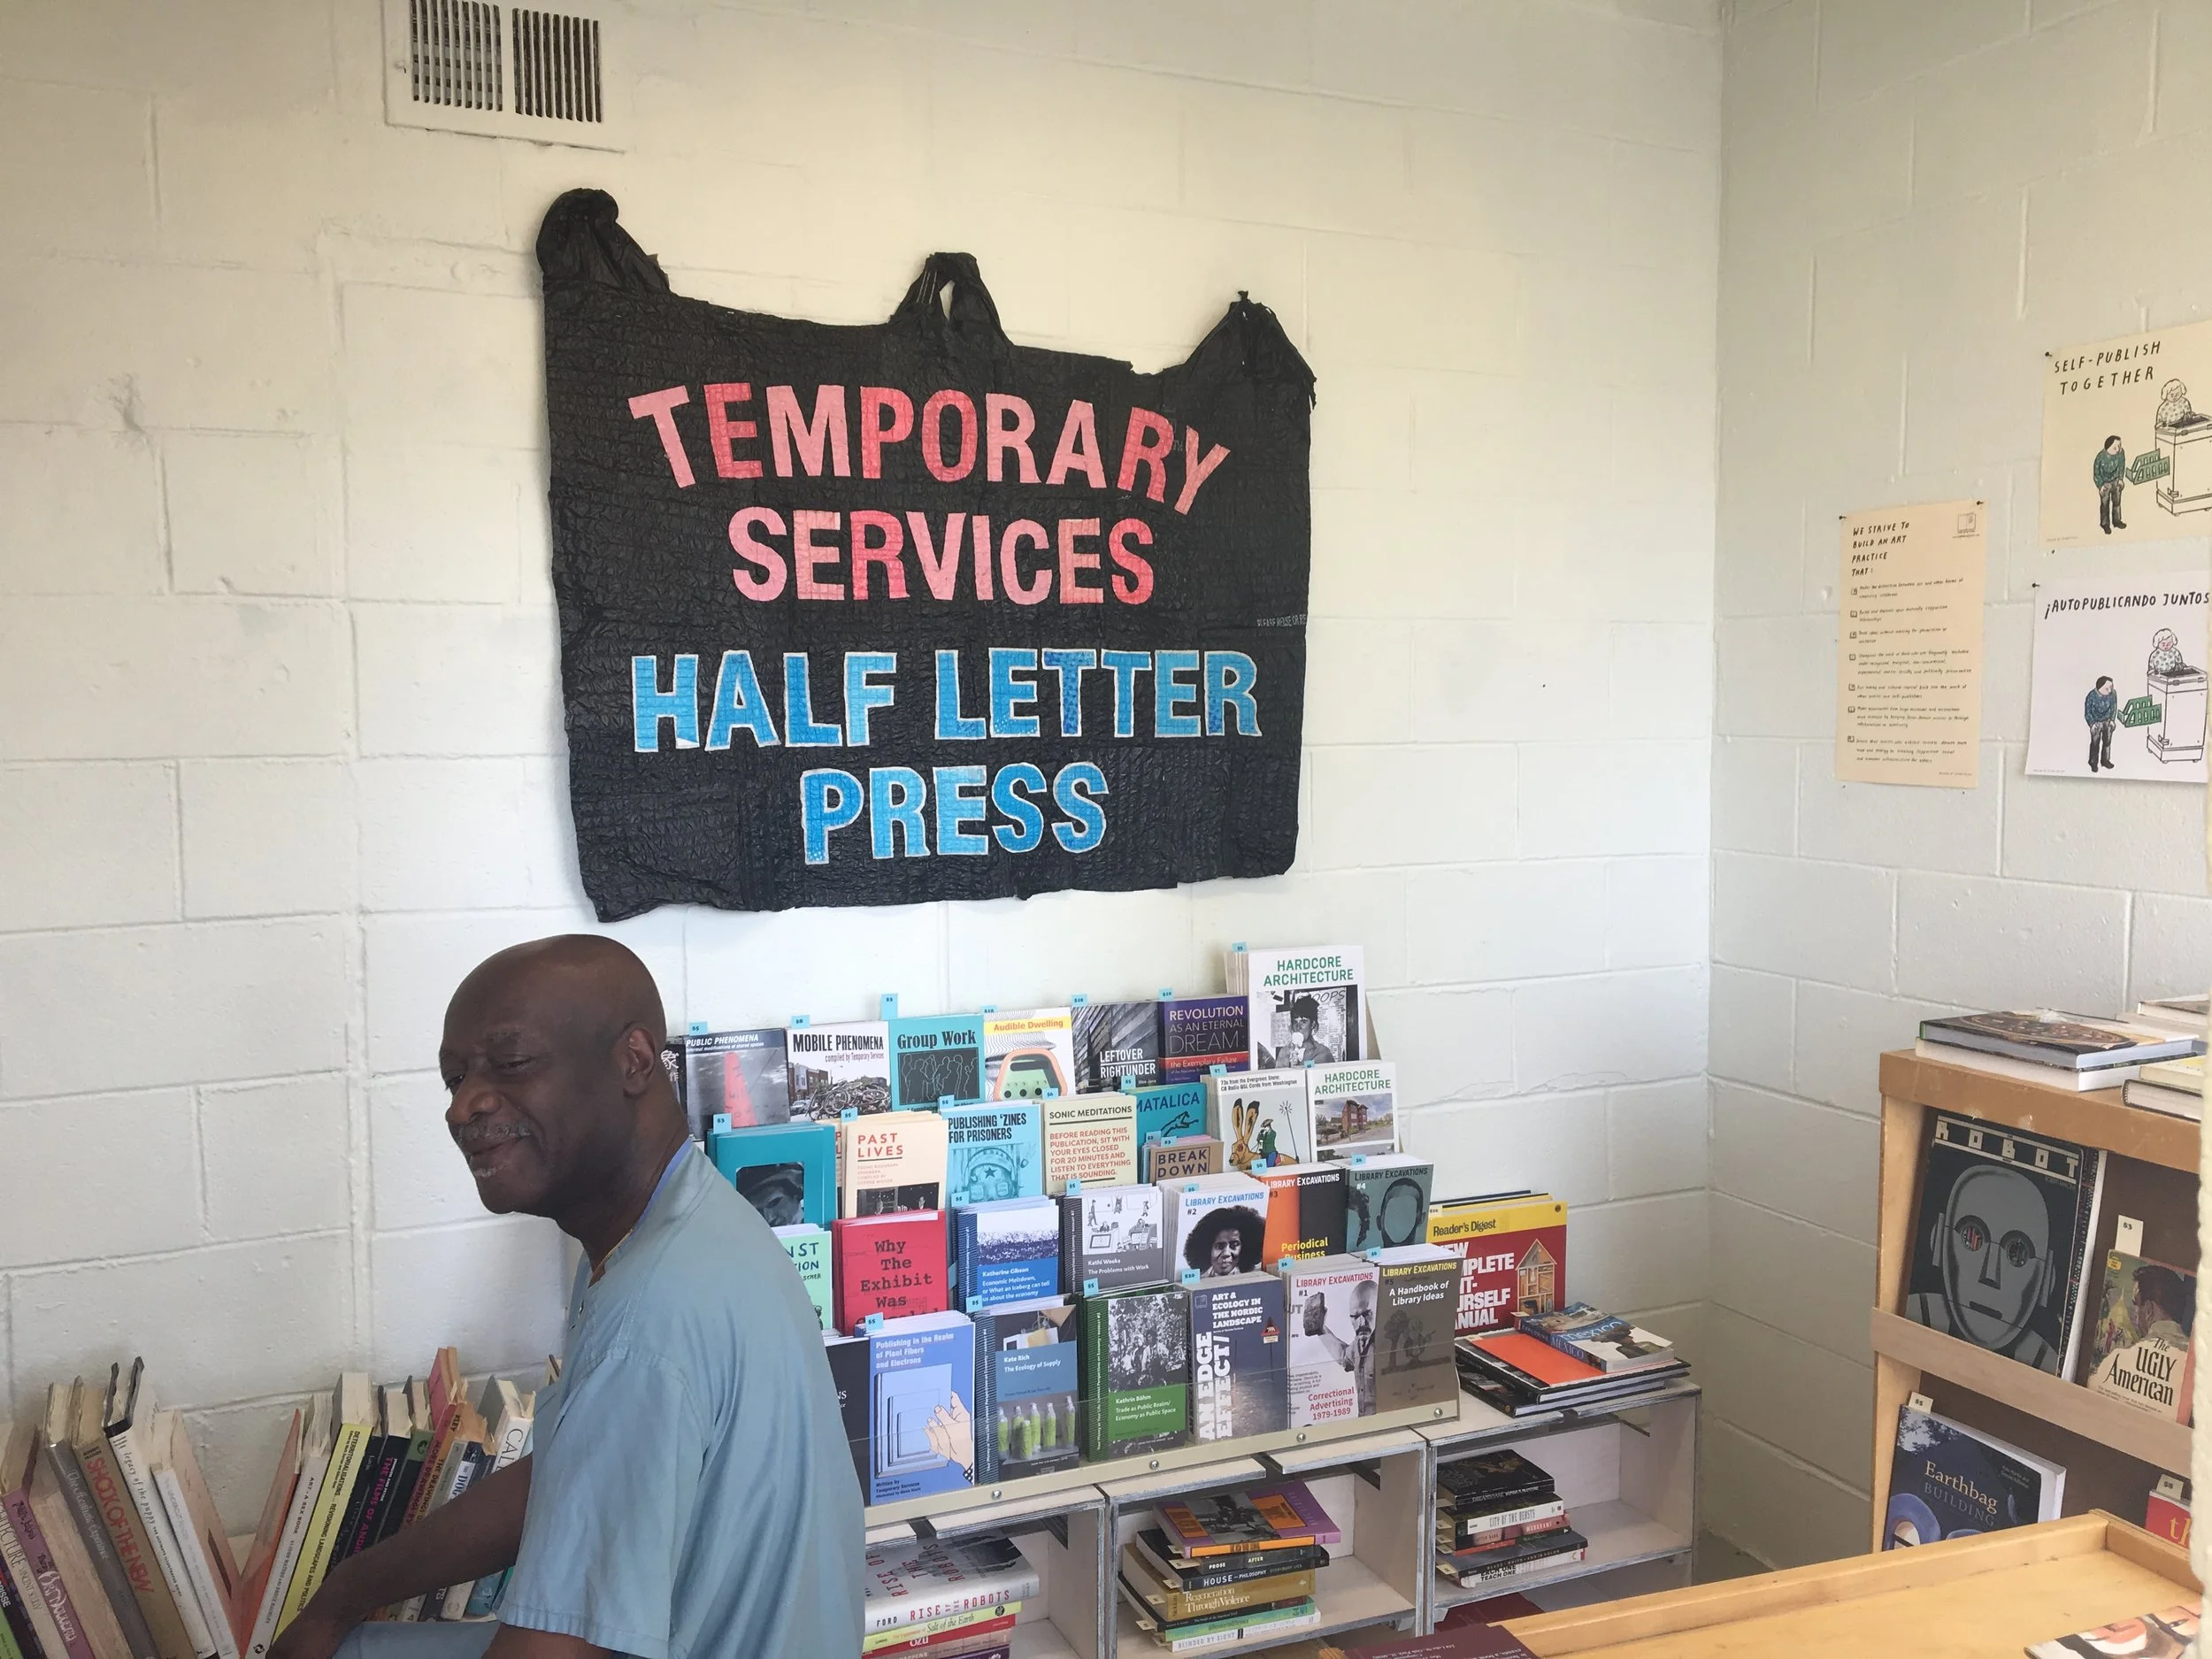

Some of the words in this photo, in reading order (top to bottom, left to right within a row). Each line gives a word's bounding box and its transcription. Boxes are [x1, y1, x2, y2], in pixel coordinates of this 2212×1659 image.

[2055, 341, 2161, 373] SELF-PUBLISH
[2060, 365, 2154, 395] TOGETHER
[628, 383, 1231, 516] TEMPORARY
[1853, 526, 1863, 536] WE
[1868, 523, 1897, 534] STRIVE
[1853, 539, 1875, 549] BUILD
[1891, 535, 1907, 544] ART
[728, 507, 1155, 604] SERVICES
[1852, 552, 1888, 564] PRACTICE
[2162, 592, 2211, 606] JUNTOS
[630, 650, 897, 752] HALF
[934, 648, 1262, 741] LETTER
[801, 762, 1110, 865] PRESS
[1277, 956, 1341, 972] HARDCORE
[1263, 969, 1354, 987] ARCHITECTURE
[1170, 1005, 1243, 1021] REVOLUTION
[994, 1022, 1025, 1032] Audible
[1027, 1019, 1064, 1030] Dwelling
[1170, 1024, 1183, 1033] AS
[1186, 1023, 1200, 1032] AN
[1202, 1020, 1244, 1030] ETERNAL
[686, 1038, 712, 1047] PUBLIC
[714, 1033, 759, 1045] PHENOMENA
[793, 1033, 833, 1052] MOBILE
[835, 1033, 884, 1051] PHENOMENA
[897, 1033, 938, 1049] Group
[941, 1029, 977, 1046] Work
[1100, 1048, 1143, 1062] LEFTOVER
[1100, 1063, 1156, 1079] RIGHTUNDER
[1325, 1070, 1380, 1084] HARDCORE
[1314, 1079, 1391, 1095] ARCHITECTURE
[1049, 1110, 1076, 1119] SONIC
[1077, 1106, 1132, 1117] MEDITATIONS
[949, 1117, 997, 1130] PUBLISHING
[857, 1133, 898, 1145] PAST
[949, 1130, 965, 1143] FOR
[967, 1127, 1012, 1142] PRISONERS
[1049, 1131, 1079, 1140] BEFORE
[1079, 1128, 1110, 1138] READING
[1049, 1138, 1099, 1148] PUBLICATION,
[1111, 1134, 1130, 1143] WITH
[857, 1145, 904, 1158] LIVES
[1050, 1148, 1072, 1156] YOUR
[1072, 1146, 1091, 1155] EYES
[1092, 1143, 1119, 1153] CLOSED
[1078, 1153, 1109, 1162] MINUTES
[1157, 1148, 1207, 1165] BREAK
[1935, 1121, 2078, 1178] ROBOT
[1051, 1164, 1075, 1173] LISTEN
[1086, 1160, 1131, 1171] EVERYTHING
[1157, 1162, 1208, 1179] DOWN
[1354, 1171, 1383, 1182] LIBRARY
[1385, 1167, 1428, 1179] EXCAVATIONS
[1051, 1173, 1070, 1182] THAT
[1079, 1169, 1118, 1179] SOUNDING.
[1266, 1179, 1294, 1190] LIBRARY
[1296, 1173, 1340, 1187] EXCAVATIONS
[1185, 1196, 1217, 1208] LIBRARY
[1217, 1191, 1264, 1204] EXCAVATIONS
[1433, 1223, 1469, 1237] Reader's
[1471, 1218, 1496, 1232] Digest
[874, 1240, 906, 1255] Why
[1281, 1237, 1328, 1252] Periodical
[880, 1257, 911, 1271] The
[1383, 1268, 1411, 1278] LIBRARY
[1414, 1262, 1456, 1274] EXCAVATIONS
[860, 1273, 933, 1293] Exhibit
[1296, 1278, 1326, 1288] LIBRARY
[1329, 1272, 1373, 1286] EXCAVATIONS
[1397, 1284, 1438, 1296] Handbook
[1440, 1280, 1449, 1289] of
[876, 1295, 907, 1309] Was
[1212, 1292, 1229, 1302] ART
[1212, 1300, 1249, 1310] ECOLOGY
[1393, 1294, 1421, 1307] Library
[1423, 1292, 1444, 1301] Ideas
[1231, 1306, 1263, 1318] NORDIC
[1212, 1316, 1262, 1329] LANDSCAPE
[1551, 1336, 1586, 1360] MEXICO
[2152, 1336, 2171, 1353] The
[1016, 1362, 1035, 1372] Ecology
[1043, 1359, 1062, 1369] Supply
[1196, 1332, 1214, 1399] EDGE
[2136, 1347, 2177, 1382] UGLY
[2103, 1354, 2174, 1407] American
[1309, 1386, 1355, 1402] Correctional
[1310, 1398, 1354, 1411] Advertising
[1198, 1403, 1216, 1440] AN
[1313, 1408, 1351, 1421] 1979-1989
[124, 1452, 136, 1475] legacy
[134, 1476, 142, 1486] of
[1924, 1459, 1998, 1515] Earthbag
[137, 1484, 147, 1500] the
[142, 1501, 156, 1525] puppy
[1924, 1482, 1995, 1529] BUILDING
[85, 1457, 120, 1507] SHOCK
[105, 1505, 124, 1532] OF
[115, 1525, 136, 1555] THE
[127, 1552, 154, 1593] NEW
[320, 1502, 336, 1540] REVISIONING
[308, 1538, 324, 1574] LANDSCAPES
[1203, 1574, 1233, 1587] HOUSE
[1239, 1571, 1266, 1579] PHILOSOPHY
[1480, 1572, 1502, 1582] TEACH
[296, 1586, 310, 1613] POLITICS
[877, 1617, 897, 1627] FORD
[910, 1604, 941, 1621] RISE
[964, 1590, 1010, 1609] ROBOTS
